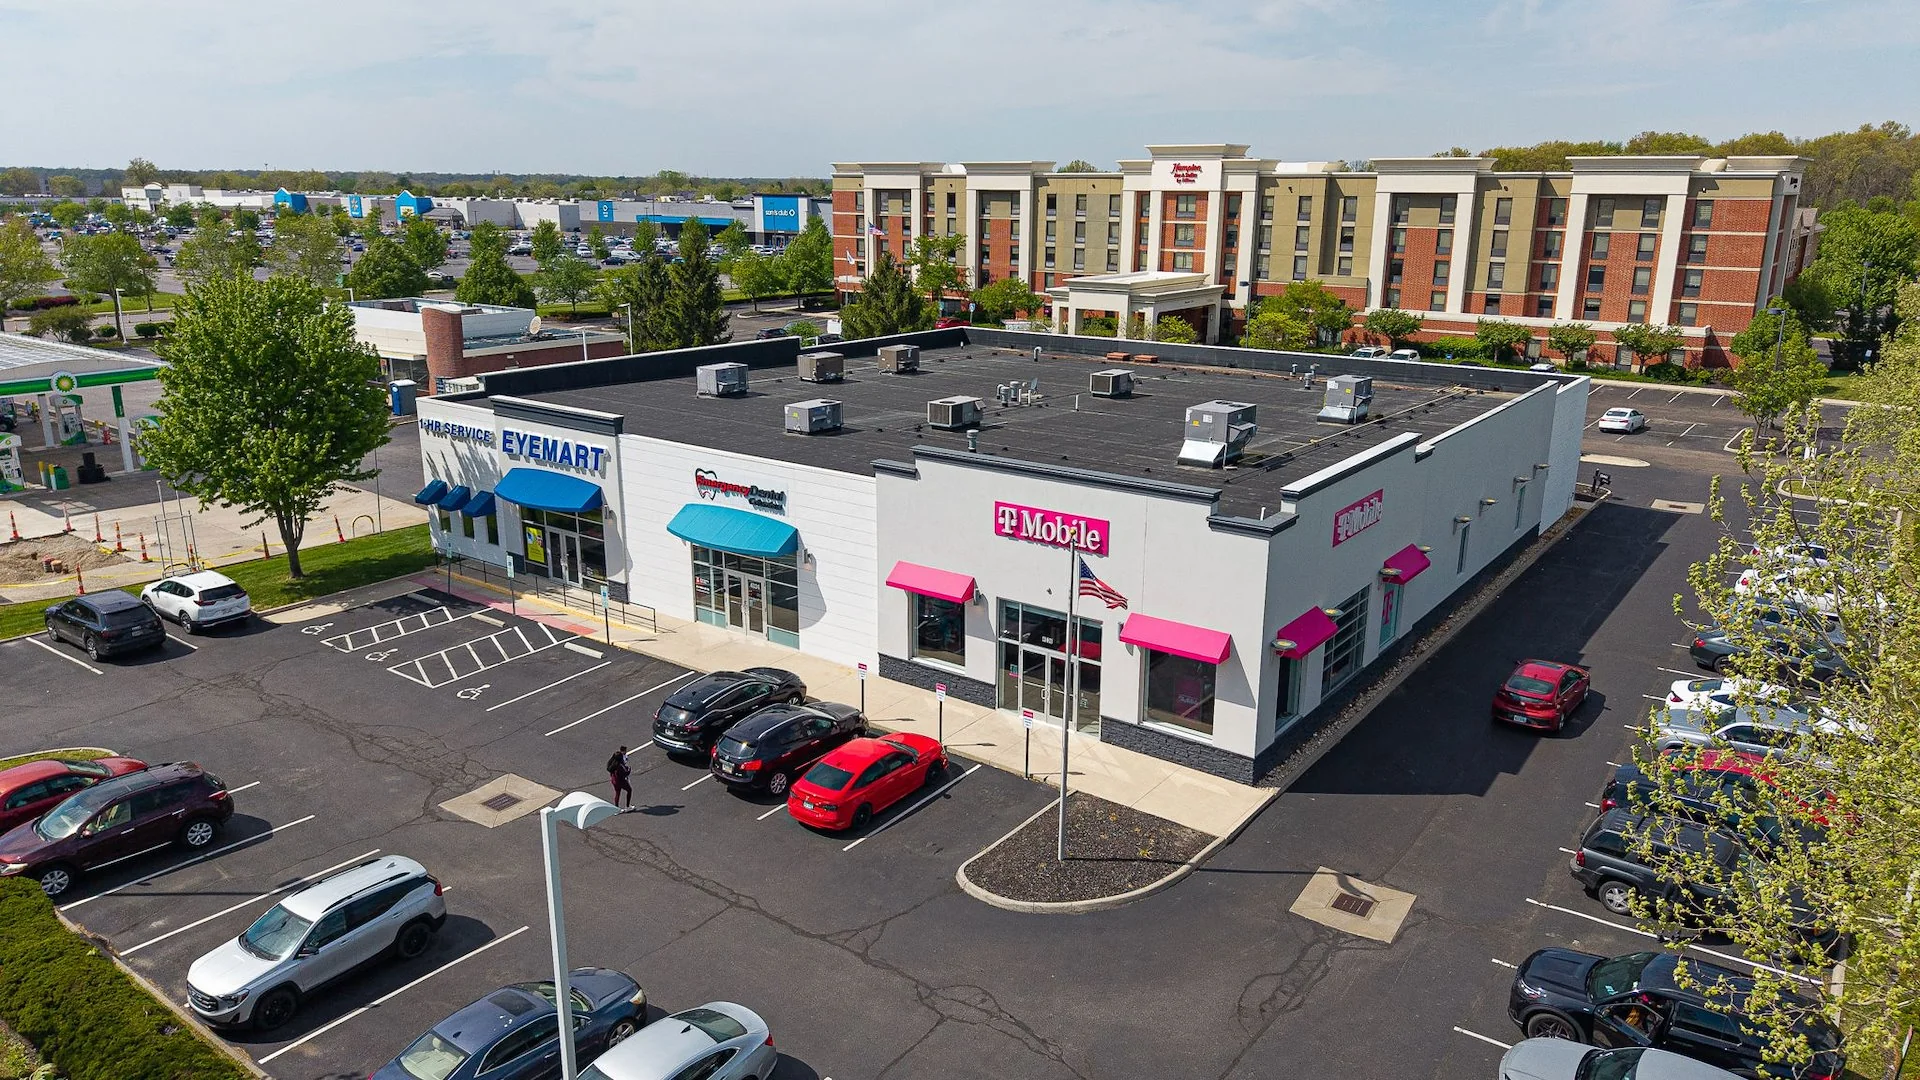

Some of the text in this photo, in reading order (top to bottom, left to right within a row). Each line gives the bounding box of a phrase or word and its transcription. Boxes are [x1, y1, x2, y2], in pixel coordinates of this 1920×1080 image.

[1170, 163, 1202, 174] Hampton
[419, 418, 491, 443] 1-HR SERVICE
[502, 429, 605, 471] EYEMART
